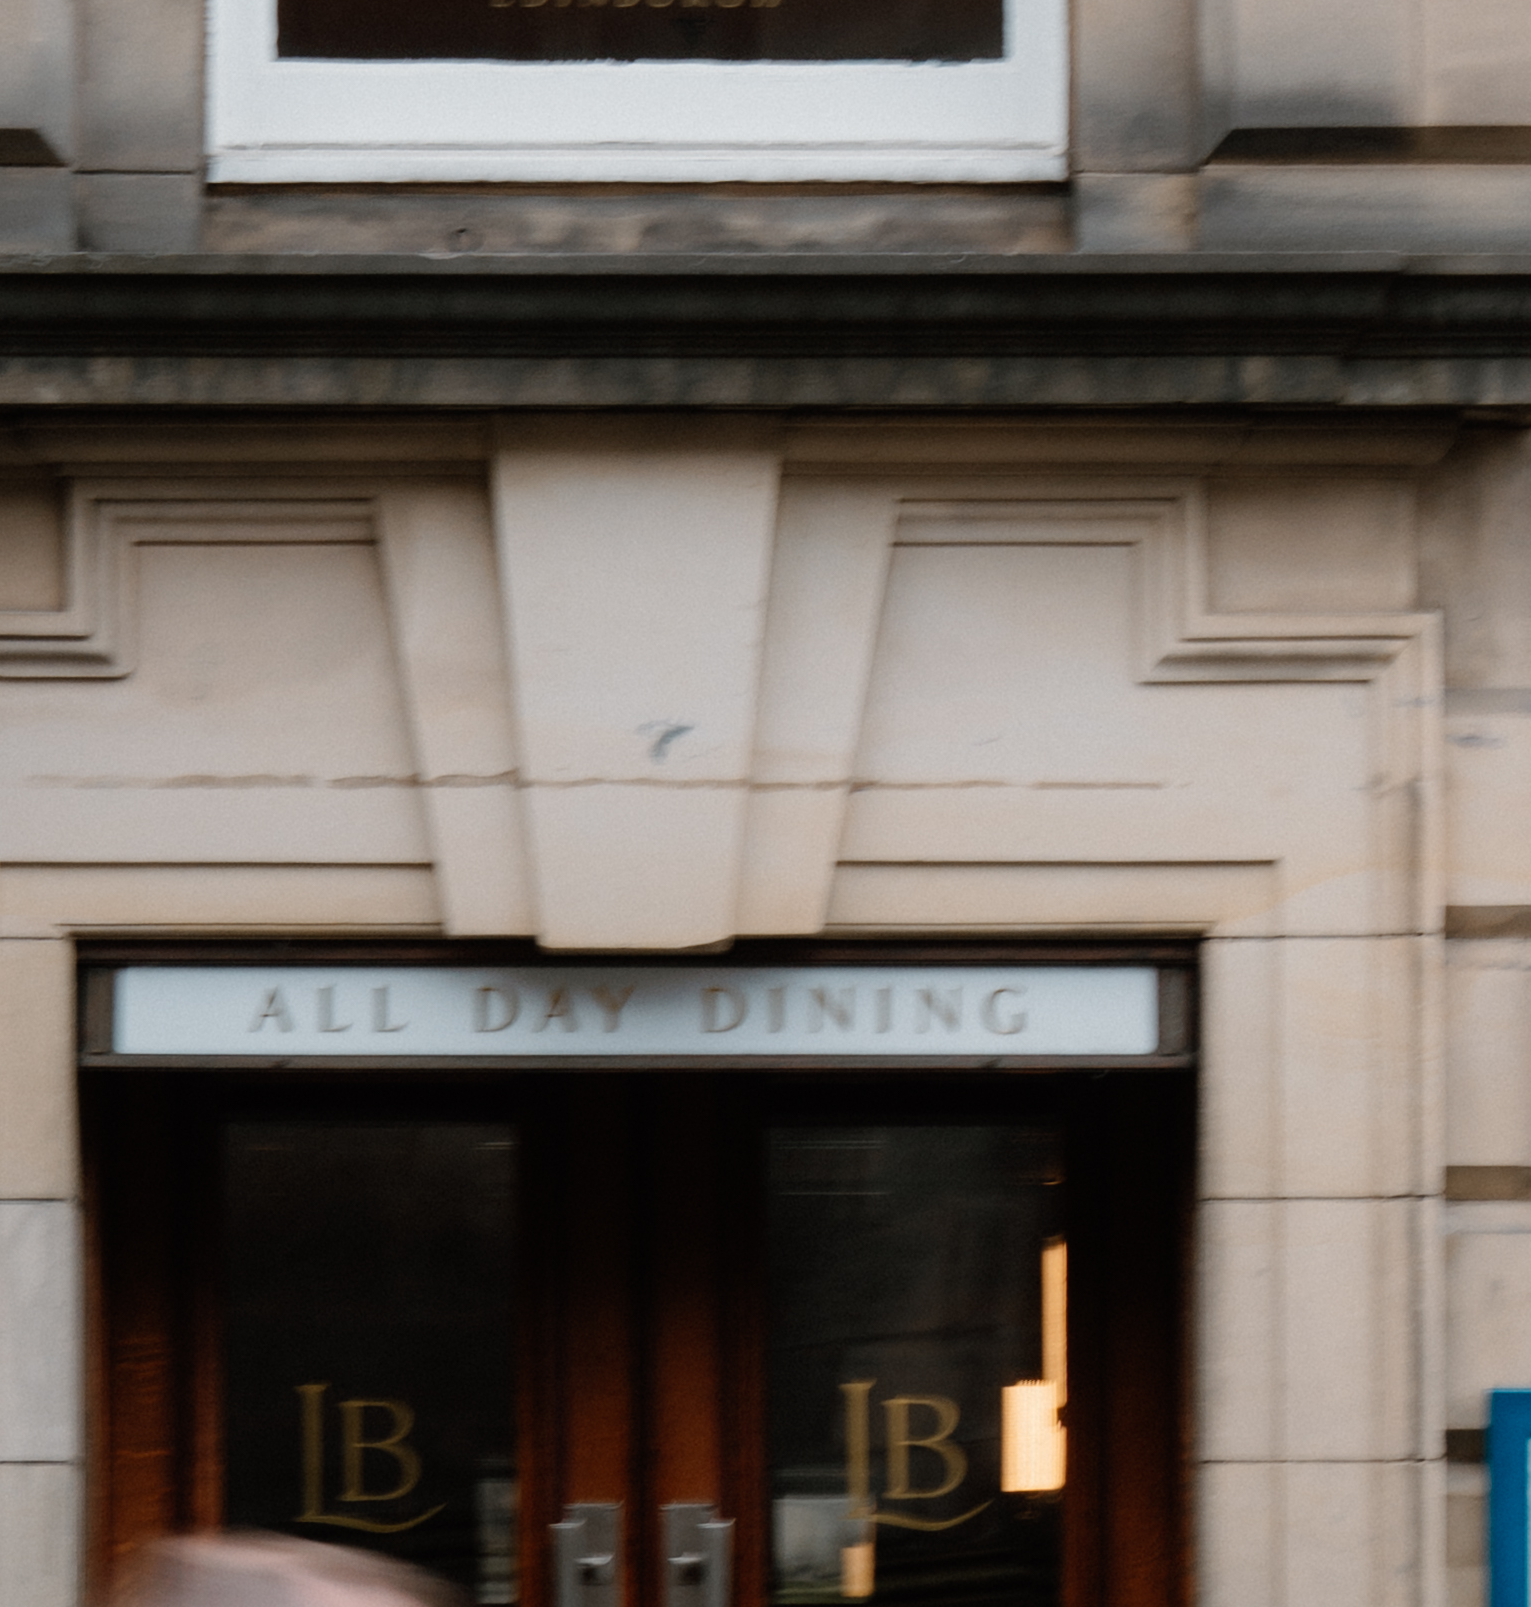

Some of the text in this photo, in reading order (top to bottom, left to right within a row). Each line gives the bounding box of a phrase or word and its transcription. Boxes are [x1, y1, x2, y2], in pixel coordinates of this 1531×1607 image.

[247, 985, 1032, 1037] ALL DAY DINING
[290, 1380, 449, 1535] LB
[837, 1377, 996, 1533] LB
